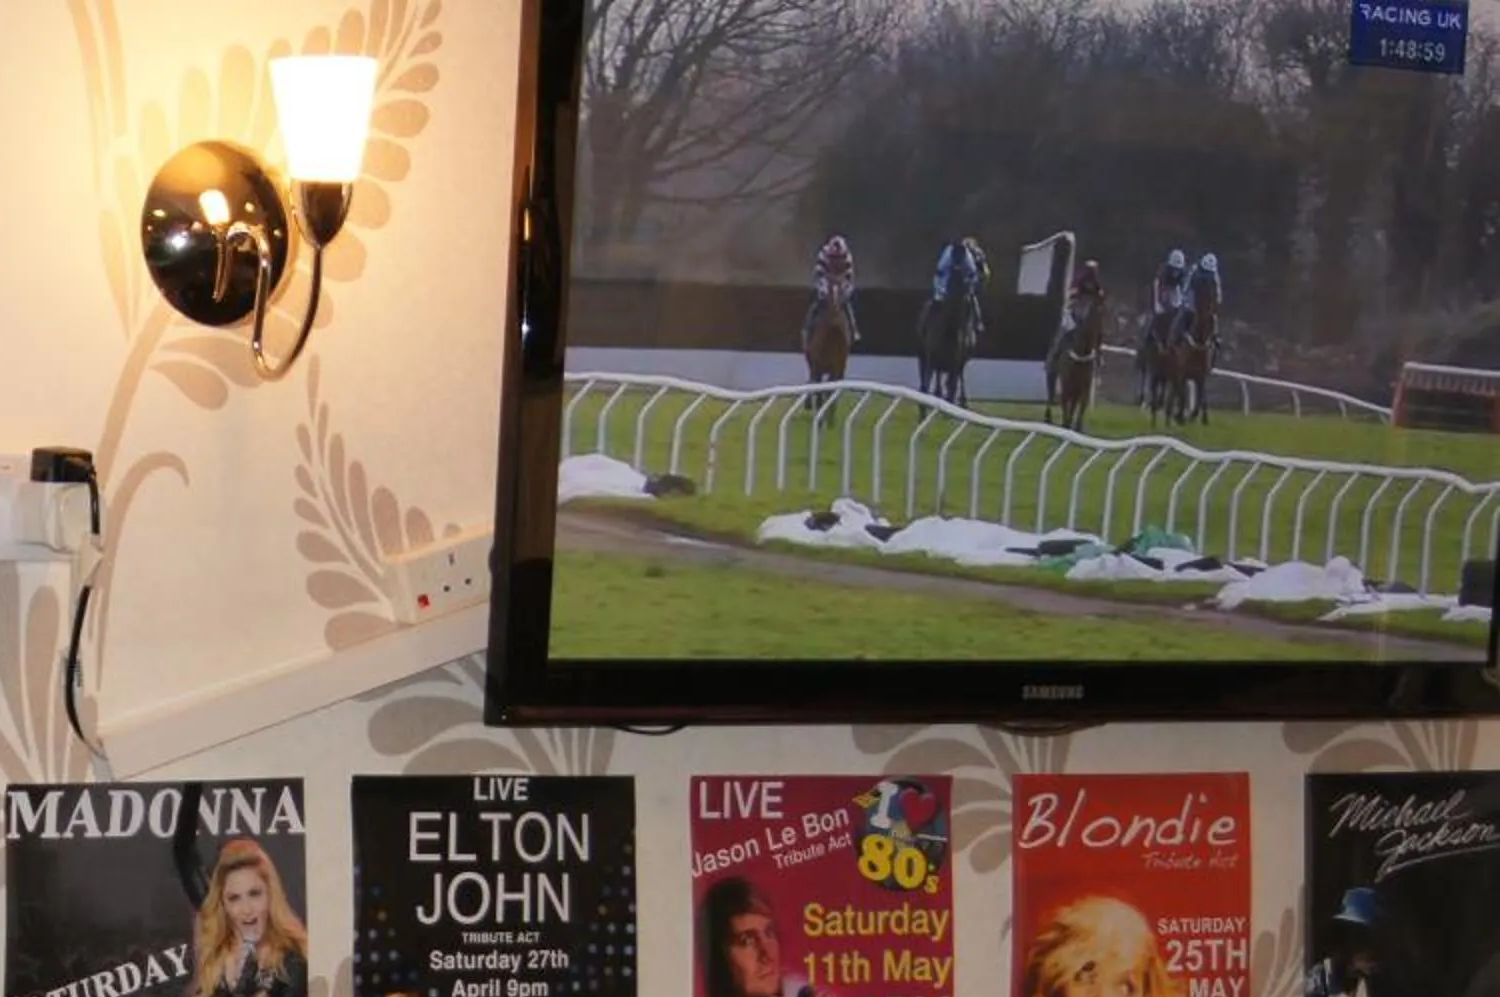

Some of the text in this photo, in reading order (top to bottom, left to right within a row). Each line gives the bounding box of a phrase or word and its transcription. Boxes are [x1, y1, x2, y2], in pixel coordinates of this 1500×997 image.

[1359, 4, 1462, 29] RACING UK
[1380, 38, 1446, 62] 1:48:59
[473, 776, 529, 801] LIVE
[699, 781, 785, 820] LIVE
[7, 785, 306, 840] MADONNA
[1018, 787, 1237, 849] Blondie
[1328, 788, 1470, 838] Michael
[409, 810, 590, 863] ELTON
[692, 807, 850, 878] Jason Le Bon
[772, 833, 852, 870] Tribute Act
[1373, 821, 1500, 884] Jackson
[1141, 850, 1202, 871] Tribute
[415, 871, 570, 925] JOHN
[461, 931, 541, 944] TRIBUTE ACT
[803, 902, 950, 942] Saturday
[1157, 916, 1246, 935] SATURDAY
[429, 949, 570, 974] Saturday 27th
[803, 949, 953, 989] 11th May
[1165, 938, 1248, 972] 25TH
